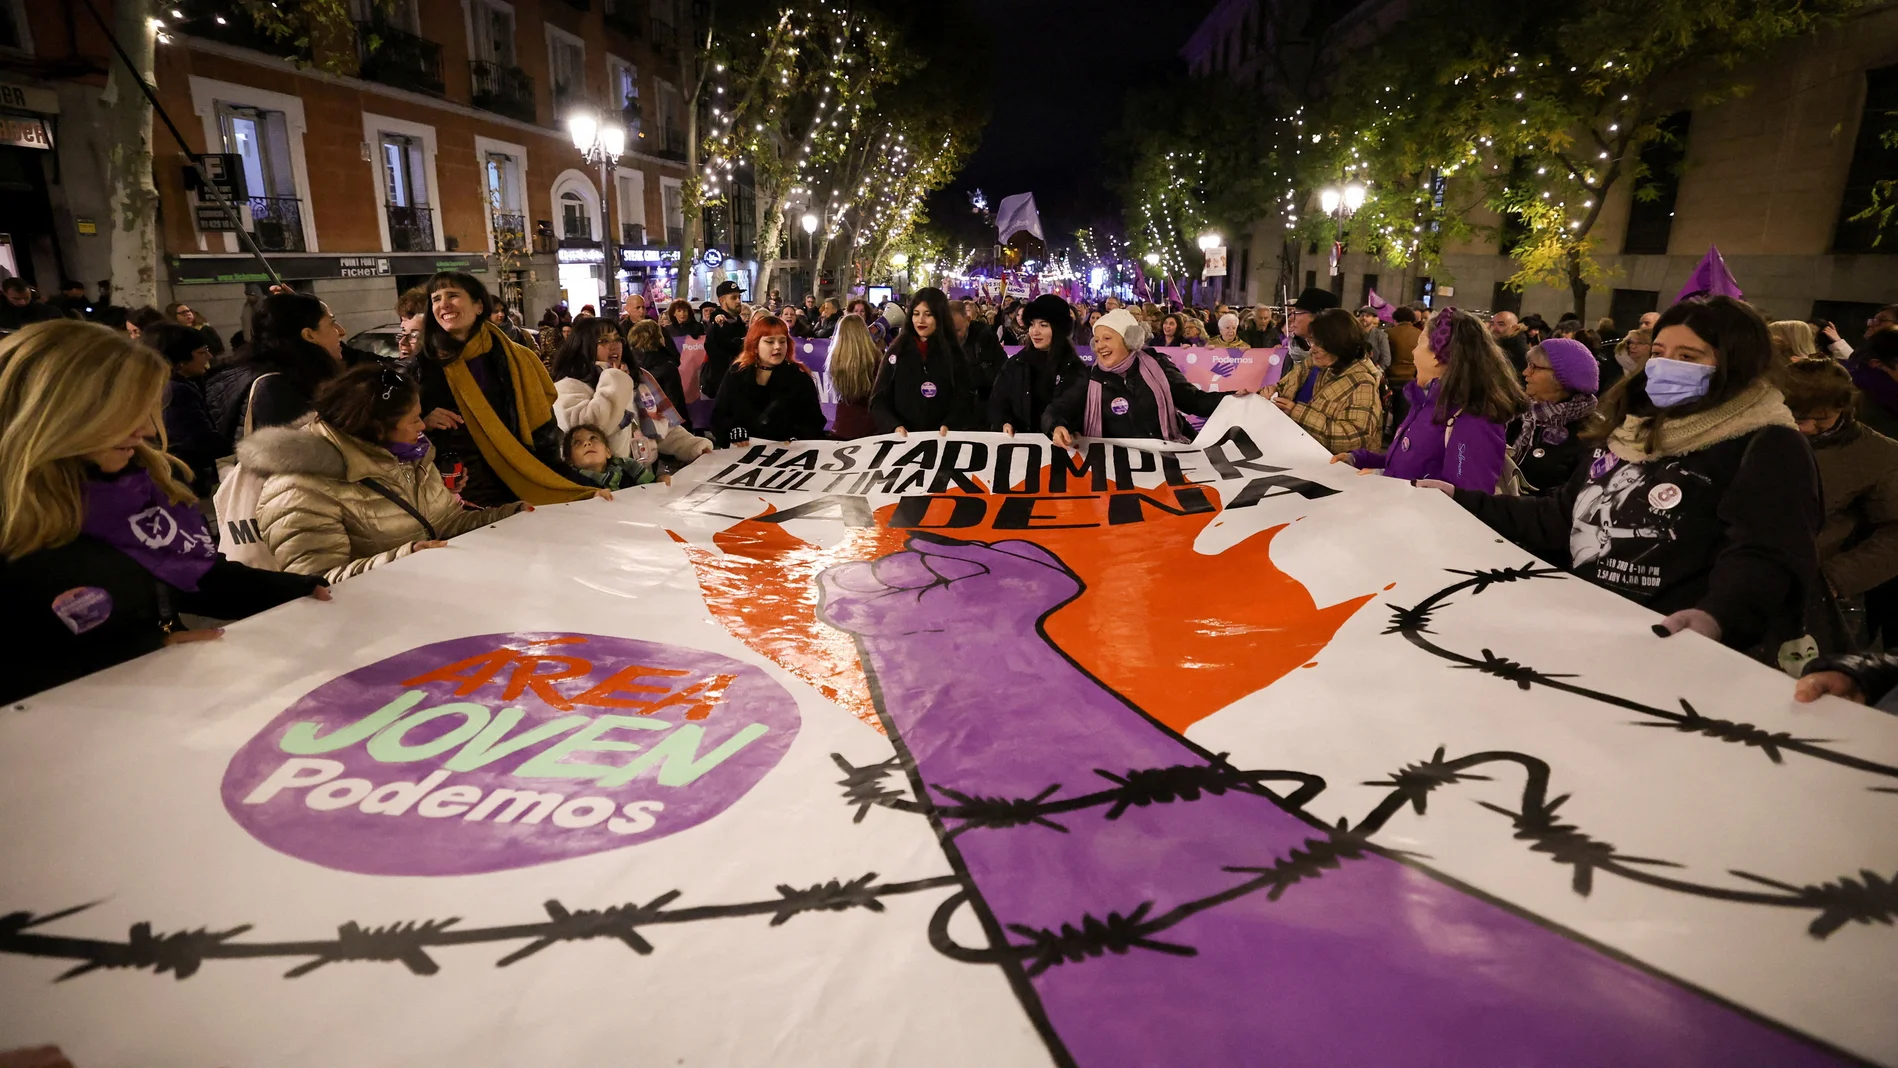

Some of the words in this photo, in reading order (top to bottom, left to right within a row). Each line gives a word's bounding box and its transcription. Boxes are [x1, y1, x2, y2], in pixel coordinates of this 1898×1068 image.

[340, 257, 359, 267] POINT
[360, 257, 375, 266] FORT
[1212, 355, 1253, 364] Podemos
[736, 439, 938, 472] HASTA
[927, 425, 1294, 495] ROMPER
[1641, 576, 1661, 587] DOOR
[279, 689, 769, 788] JOVEN
[242, 757, 665, 834] Podemos
